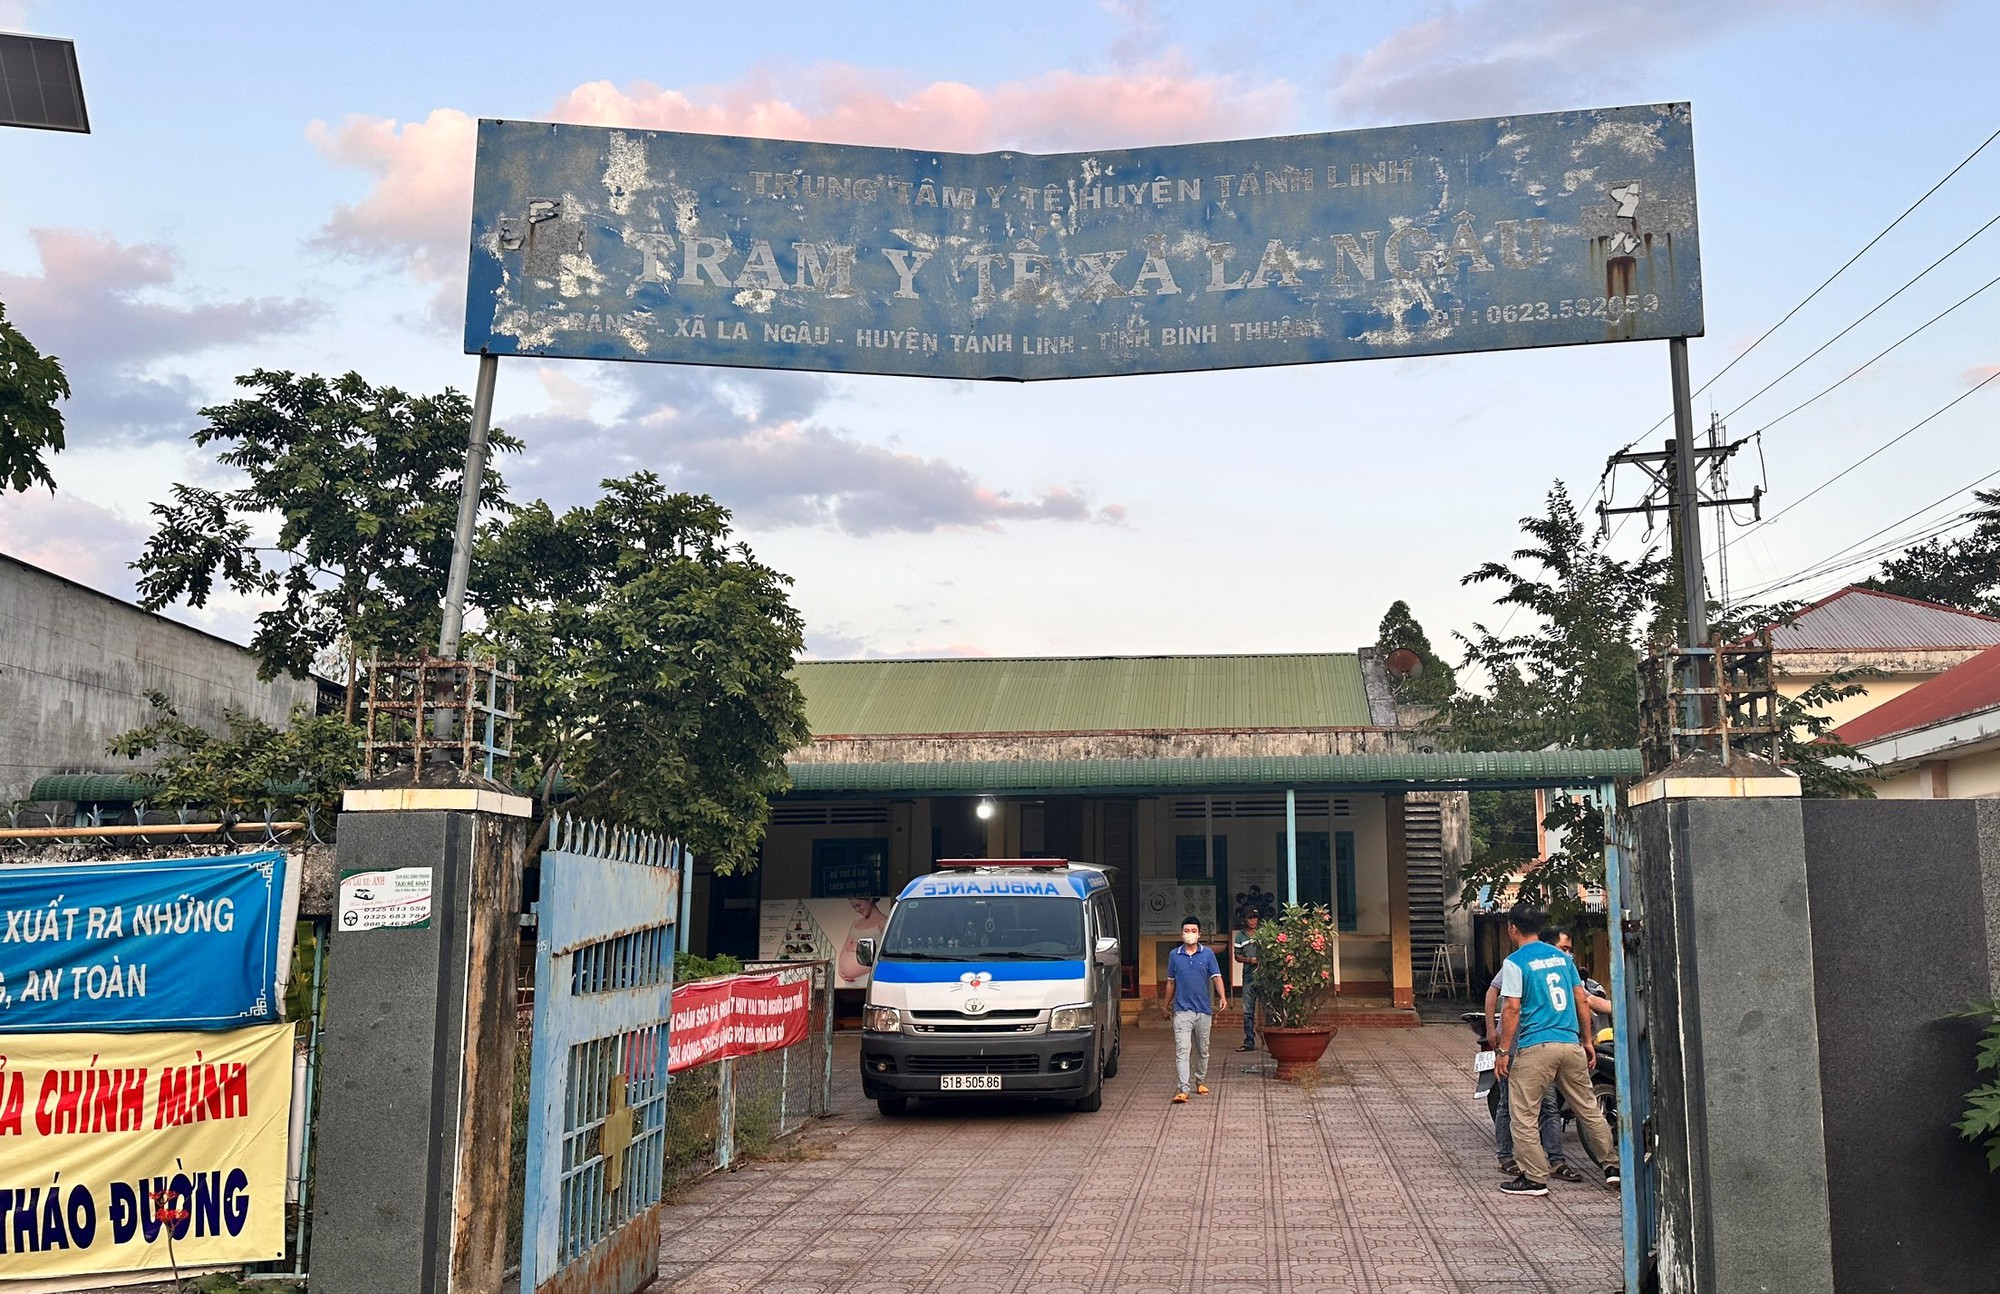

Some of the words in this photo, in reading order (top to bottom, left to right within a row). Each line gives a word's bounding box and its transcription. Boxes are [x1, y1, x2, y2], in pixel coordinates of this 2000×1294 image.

[749, 171, 877, 201] TRUNG
[892, 178, 973, 210] TÂM
[985, 185, 1007, 209] Y
[1079, 175, 1200, 210] HUYỆN
[1327, 158, 1413, 189] LINH
[881, 248, 933, 299] Y
[1206, 238, 1302, 292] LA
[1330, 210, 1545, 285] NGÂU
[674, 314, 707, 339] XÃ
[718, 320, 749, 341] LA
[764, 320, 830, 345] NGÂU
[857, 327, 938, 354] HUYỆN
[1023, 336, 1074, 355] LINH
[1161, 319, 1217, 346] BÌNH
[3, 894, 80, 943] XUẤT
[86, 906, 124, 939] RA
[133, 893, 235, 936] NHỮNG
[20, 968, 63, 1002] AN
[71, 955, 147, 1000] TOÀN
[1546, 972, 1567, 1011] 6
[35, 1054, 148, 1136] CHÍNH
[154, 1050, 249, 1130] MÌNH
[109, 1158, 250, 1244] ĐƯỜNG
